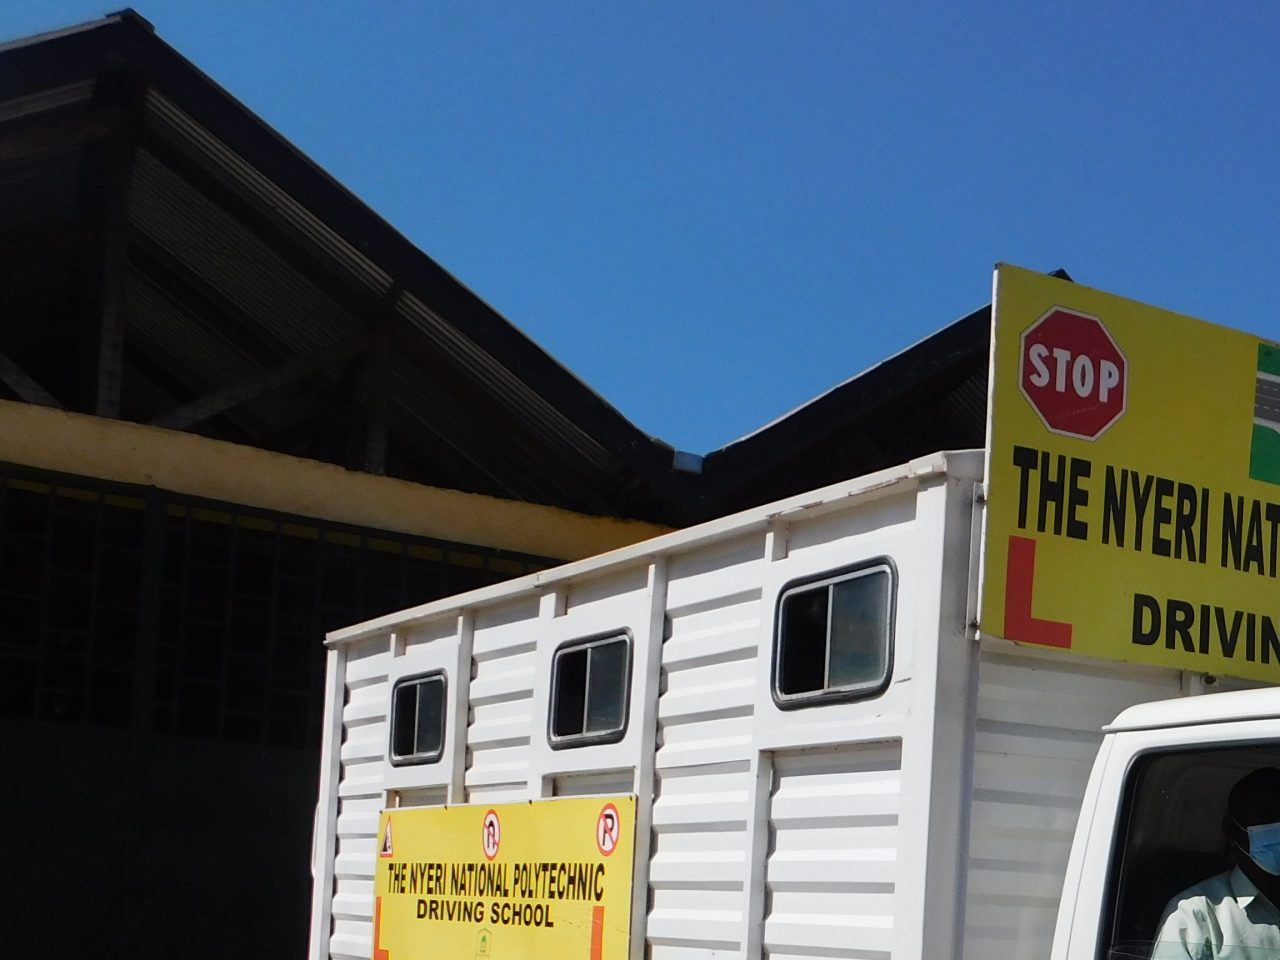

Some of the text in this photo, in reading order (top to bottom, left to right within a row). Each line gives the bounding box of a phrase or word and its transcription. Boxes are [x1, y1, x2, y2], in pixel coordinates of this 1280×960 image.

[1028, 343, 1120, 403] STOP
[1013, 446, 1092, 540] THE
[1102, 465, 1209, 564] NYERI
[388, 862, 606, 902] THE NYERI NATIONAL POLYTECHNIC
[416, 899, 554, 928] DRIVING SCHOOL
